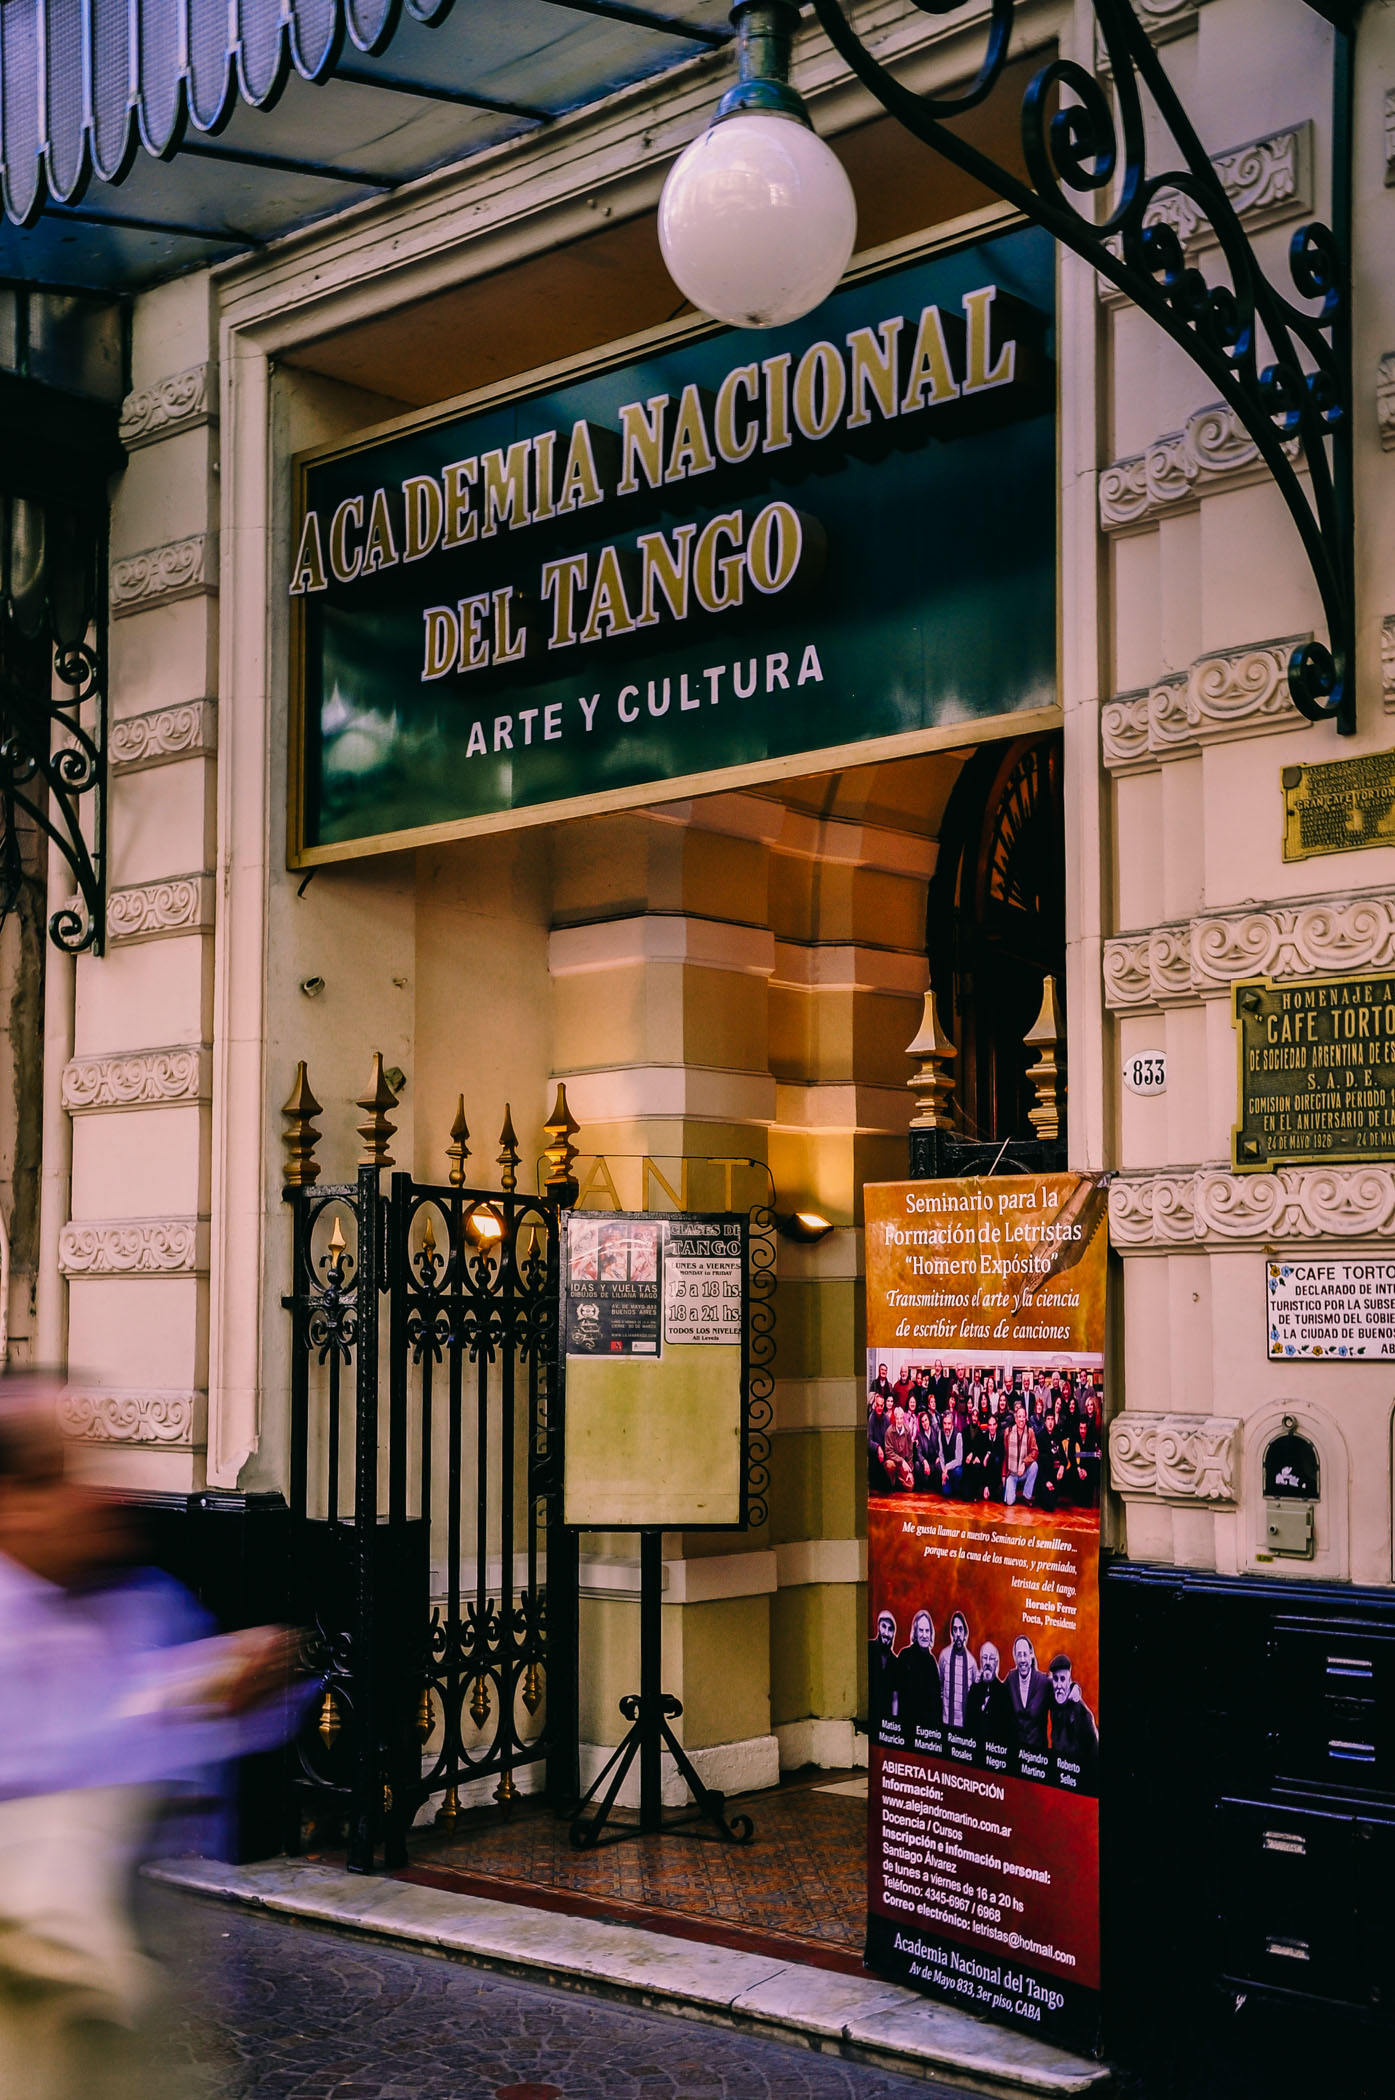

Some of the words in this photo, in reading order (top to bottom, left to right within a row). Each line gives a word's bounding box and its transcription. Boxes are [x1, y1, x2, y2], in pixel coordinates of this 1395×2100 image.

[289, 419, 604, 596] ACADEMIA
[616, 284, 1016, 496] NACIONAL
[421, 586, 527, 682] DEL
[541, 501, 803, 649] TANGO
[465, 702, 562, 758] ARTE
[577, 694, 601, 731] Y
[617, 644, 824, 723] CULTURA
[1282, 985, 1373, 1010] HOMENAJE
[1250, 1049, 1260, 1072] DE
[1263, 1046, 1307, 1071] SOCIEDAD
[1312, 1042, 1364, 1068] ARGENTINA
[1369, 1041, 1381, 1065] DE
[1132, 1058, 1166, 1086] 833
[1249, 1095, 1291, 1115] COMISION
[1294, 1091, 1342, 1112] DIRECTIVA
[1345, 1089, 1386, 1108] PERIODO
[1263, 1114, 1276, 1132] EN
[1280, 1113, 1292, 1131] EL
[1297, 1110, 1364, 1130] ANIVERSARIO
[1368, 1109, 1381, 1127] DE
[1279, 1134, 1288, 1150] DE
[1289, 1134, 1310, 1149] MAYO
[1369, 1132, 1379, 1146] DE
[906, 1191, 993, 1214] Seminario
[998, 1190, 1037, 1216] para
[1042, 1186, 1059, 1208] la
[884, 1223, 976, 1246] Formación
[978, 1222, 1002, 1243] de
[1005, 1221, 1082, 1243] Letristas
[670, 1240, 741, 1256] TANGO
[905, 1255, 977, 1276] "Homero
[980, 1252, 1059, 1279] Expósito"
[1295, 1267, 1336, 1281] CAFE
[1342, 1265, 1395, 1280] TORTO
[570, 1283, 595, 1292] IDAS
[600, 1284, 606, 1292] Y
[611, 1284, 658, 1293] VUELTAS
[669, 1280, 687, 1298] 15
[689, 1283, 699, 1298] a
[702, 1281, 720, 1298] 18
[885, 1288, 969, 1308] Transmitimos
[971, 1287, 982, 1307] el
[983, 1290, 1010, 1307] arte
[1010, 1293, 1020, 1314] y
[1020, 1287, 1033, 1308] la
[1035, 1290, 1080, 1308] ciencia
[1295, 1284, 1356, 1296] DECLARADO
[1359, 1284, 1372, 1295] DE
[669, 1304, 687, 1322] 18
[689, 1307, 699, 1322] a
[702, 1304, 720, 1322] 21
[1270, 1300, 1322, 1311] TURISTICO
[1324, 1299, 1345, 1310] POR
[1348, 1299, 1361, 1310] LA
[896, 1318, 911, 1337] de
[913, 1319, 958, 1338] escribir
[959, 1318, 990, 1339] letras
[993, 1318, 1010, 1339] de
[1012, 1321, 1071, 1340] canciones
[1278, 1314, 1291, 1324] DE
[1294, 1313, 1340, 1324] TURISMO
[1343, 1313, 1362, 1324] DEL
[1283, 1329, 1297, 1339] LA
[1301, 1328, 1339, 1339] CIUDAD
[1341, 1328, 1354, 1338] DE
[902, 1521, 916, 1533] Me
[916, 1525, 936, 1537] gusta
[937, 1524, 960, 1538] llamar
[960, 1530, 966, 1539] a
[991, 1531, 1026, 1547] Seminario
[1027, 1536, 1036, 1547] el
[923, 1546, 948, 1559] porque
[949, 1549, 957, 1558] es
[958, 1547, 966, 1559] la
[982, 1551, 991, 1562] de
[992, 1552, 1003, 1564] los
[1030, 1560, 1037, 1571] y
[1011, 1575, 1040, 1590] letristas
[1041, 1580, 1055, 1592] del
[1025, 1597, 1056, 1612] Horacio
[986, 1755, 1007, 1770] Negro
[882, 1760, 927, 1781] ABIERTA
[927, 1769, 941, 1784] LA
[941, 1772, 1005, 1801] INSCRIPCIÓN
[882, 1775, 944, 1801] Información:
[882, 1794, 1013, 1838] www.alejandromartino.com.ar
[882, 1808, 926, 1832] Docencia
[932, 1821, 963, 1841] Cursos
[882, 1825, 937, 1850] Inscripción
[937, 1842, 944, 1852] e
[945, 1842, 1002, 1870] información
[1003, 1861, 1051, 1885] personal:
[882, 1842, 923, 1864] Santiago
[924, 1850, 957, 1874] Álvarez
[882, 1859, 894, 1872] de
[894, 1862, 921, 1879] lunes
[922, 1871, 929, 1882] a
[930, 1872, 962, 1892] viernes
[962, 1883, 974, 1896] de
[976, 1886, 988, 1901] 16
[989, 1893, 997, 1903] a
[998, 1893, 1012, 1908] 20
[1012, 1897, 1024, 1913] hs
[882, 1874, 923, 1897] Teléfono:
[924, 1887, 970, 1912] 4345-6967
[977, 1904, 1001, 1923] 6968
[882, 1891, 915, 1912] Correo
[916, 1902, 971, 1931] electrónico:
[972, 1919, 1076, 1967] letristas@hotmail.com
[893, 1932, 948, 1966] Academia
[949, 1951, 1001, 1986] Nacional
[1003, 1970, 1023, 1994] del
[1026, 1977, 1065, 2011] Tango
[909, 1961, 921, 1976] Av
[921, 1966, 932, 1980] de
[932, 1969, 956, 1990] Mayo
[956, 1978, 975, 1998] 833,
[976, 1985, 993, 2002] 3er
[1014, 1999, 1041, 2022] CABA
